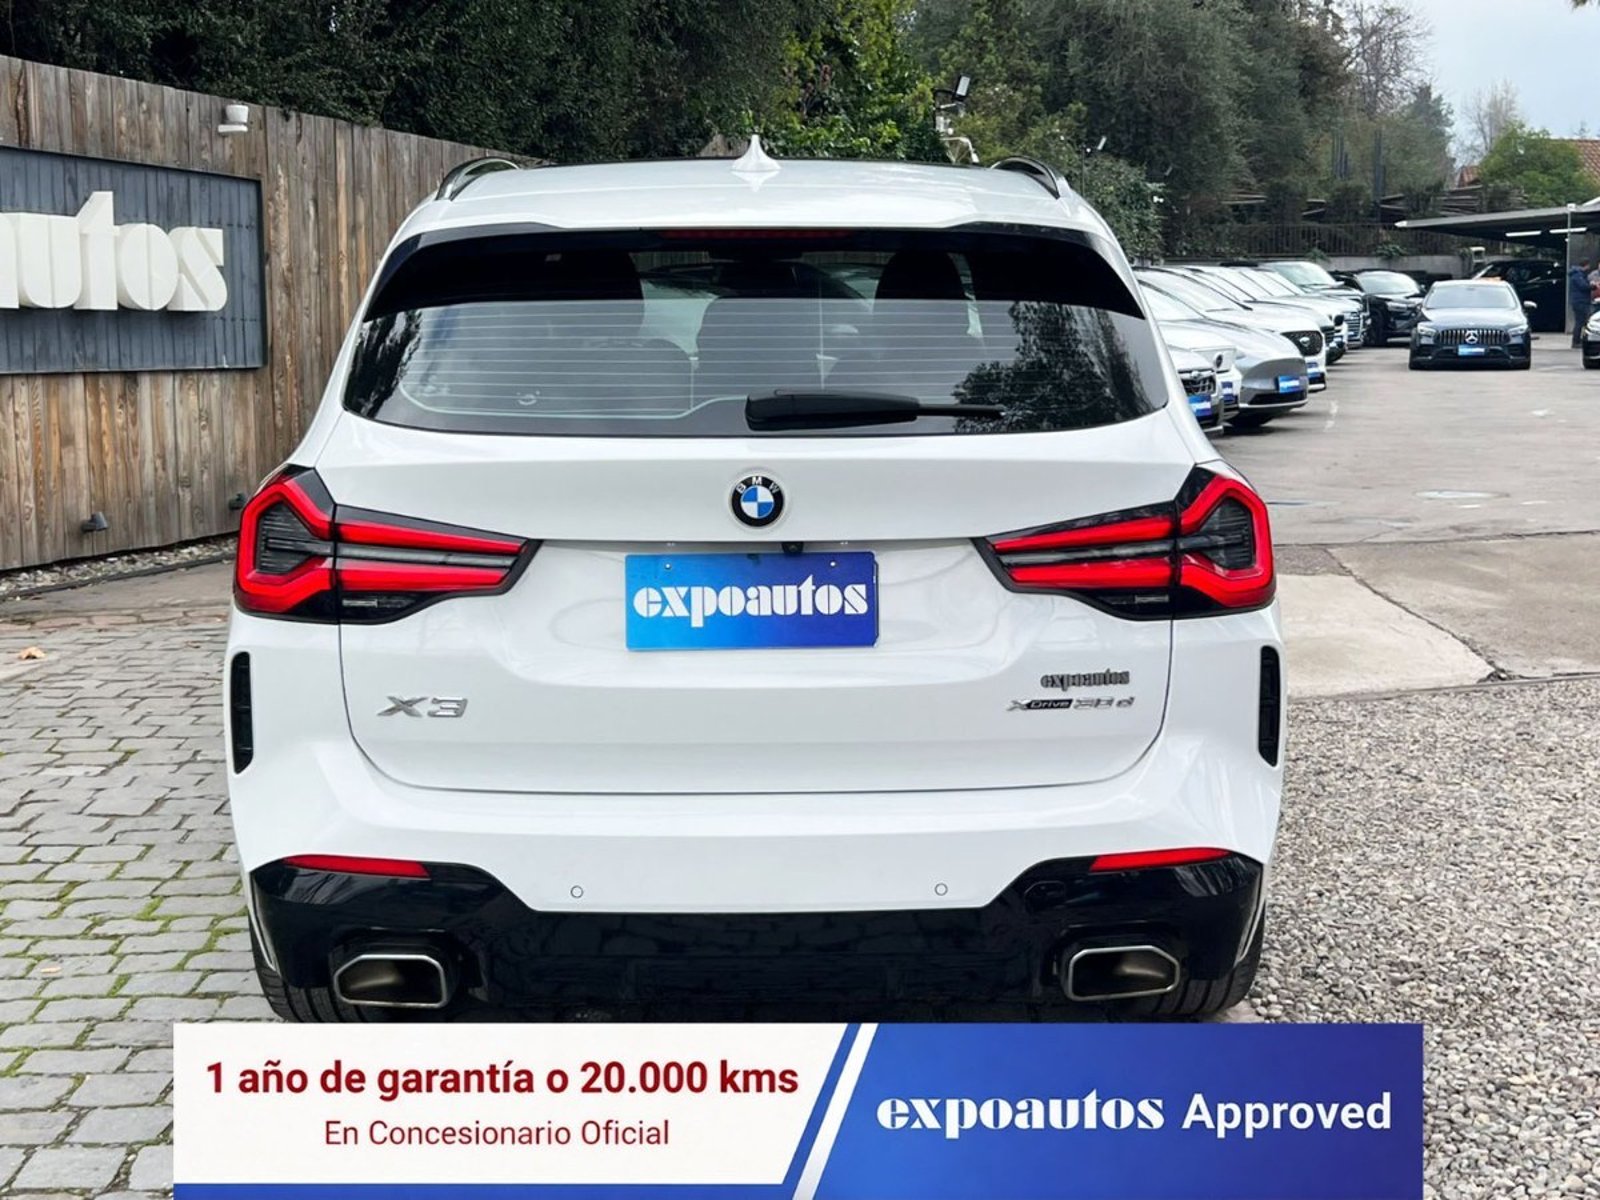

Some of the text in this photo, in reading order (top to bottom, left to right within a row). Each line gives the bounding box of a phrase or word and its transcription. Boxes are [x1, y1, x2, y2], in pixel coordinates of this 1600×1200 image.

[736, 475, 780, 494] BMW
[633, 574, 869, 628] expoautos
[377, 695, 468, 718] X3
